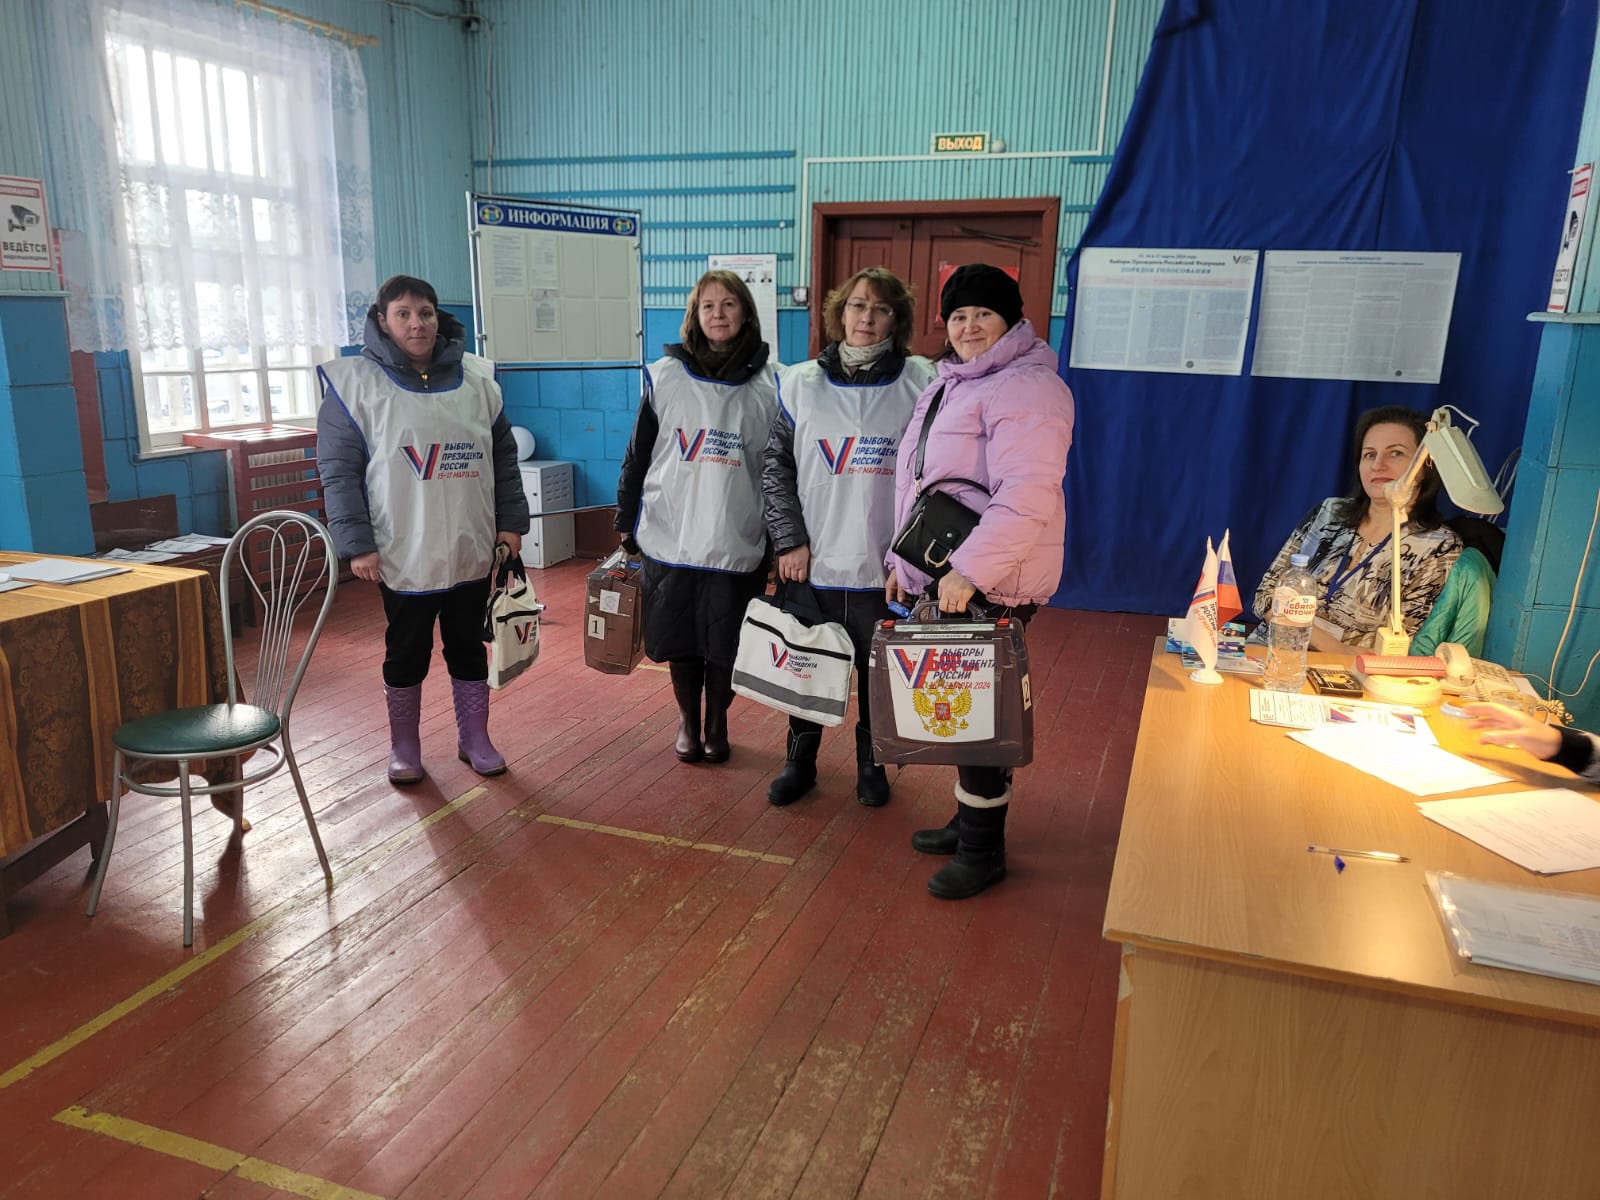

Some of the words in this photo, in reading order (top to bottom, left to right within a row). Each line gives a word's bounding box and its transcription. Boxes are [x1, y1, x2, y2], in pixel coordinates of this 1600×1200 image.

[937, 136, 983, 151] ВЫХОД
[508, 208, 609, 231] ИНФОРМАЦИЯ
[2, 240, 48, 252] ВЕДЁТСЯ
[708, 429, 742, 440] ВЫБОРЫ
[444, 442, 475, 450] ВЫБОРЫ
[705, 438, 745, 450] ПРЕЗИДЕН
[858, 436, 896, 446] ВЫБОРЫ
[441, 451, 484, 460] ПРЕЗИДЕНТА
[703, 447, 729, 456] РОССИИ
[855, 447, 898, 457] ПРЕЗИДЕН
[440, 462, 469, 470] РОССИИ
[850, 457, 883, 466] РОССИИ
[591, 620, 601, 635] 1
[941, 648, 984, 656] ВЫБОРЫ
[932, 671, 972, 680] РОССИИ
[973, 681, 990, 689] 2024
[1023, 680, 1030, 704] 2
